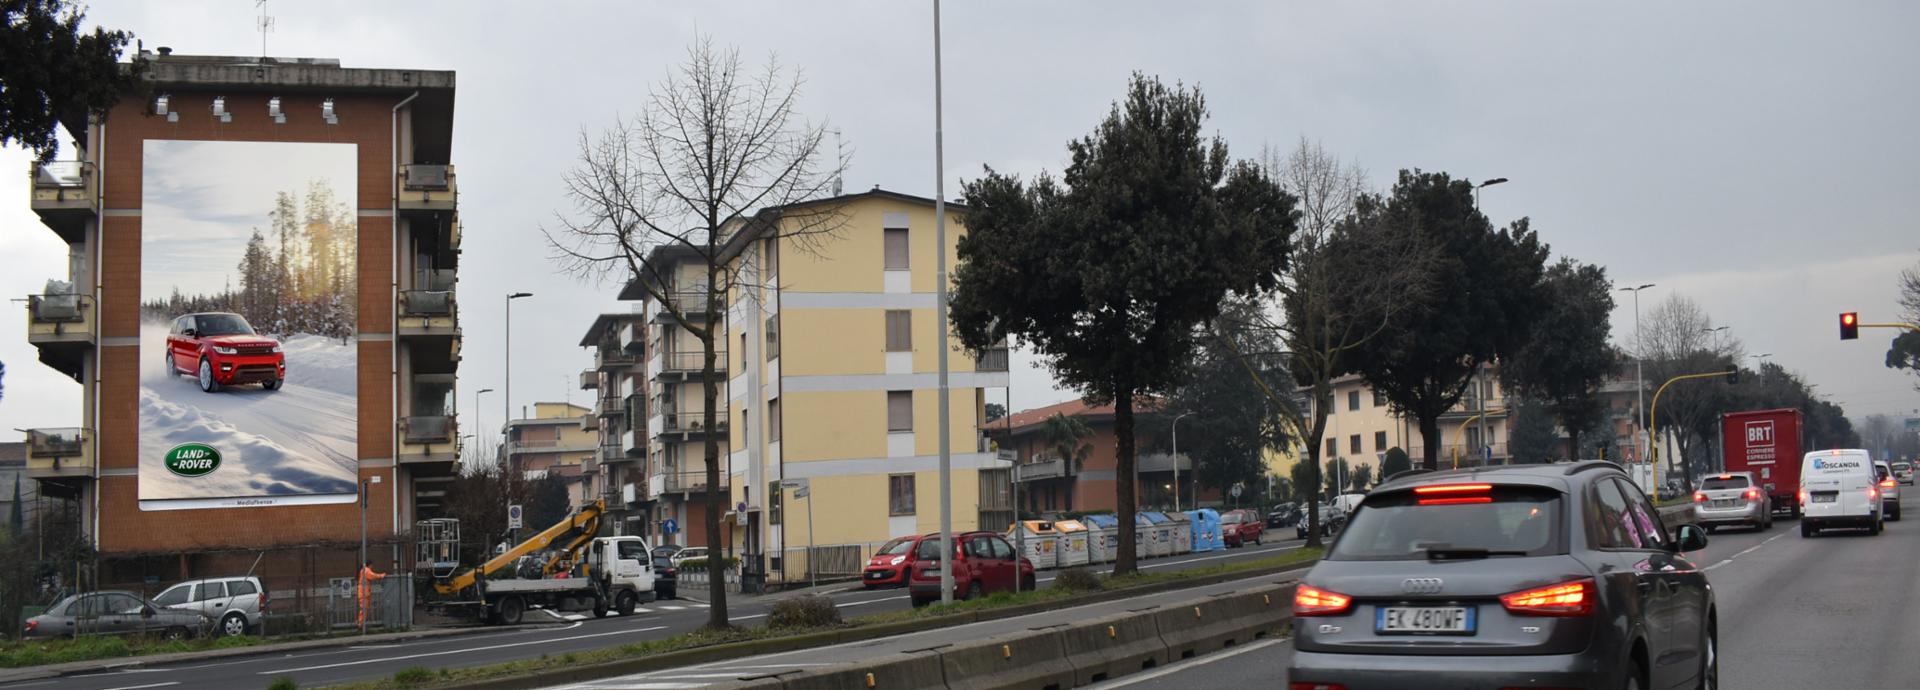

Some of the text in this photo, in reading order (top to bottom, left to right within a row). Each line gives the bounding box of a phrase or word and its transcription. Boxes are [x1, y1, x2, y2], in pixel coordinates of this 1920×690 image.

[1748, 426, 1771, 441] BRT
[176, 449, 204, 459] LAND
[178, 459, 212, 469] ROVER
[1387, 609, 1465, 628] EK 480WF
